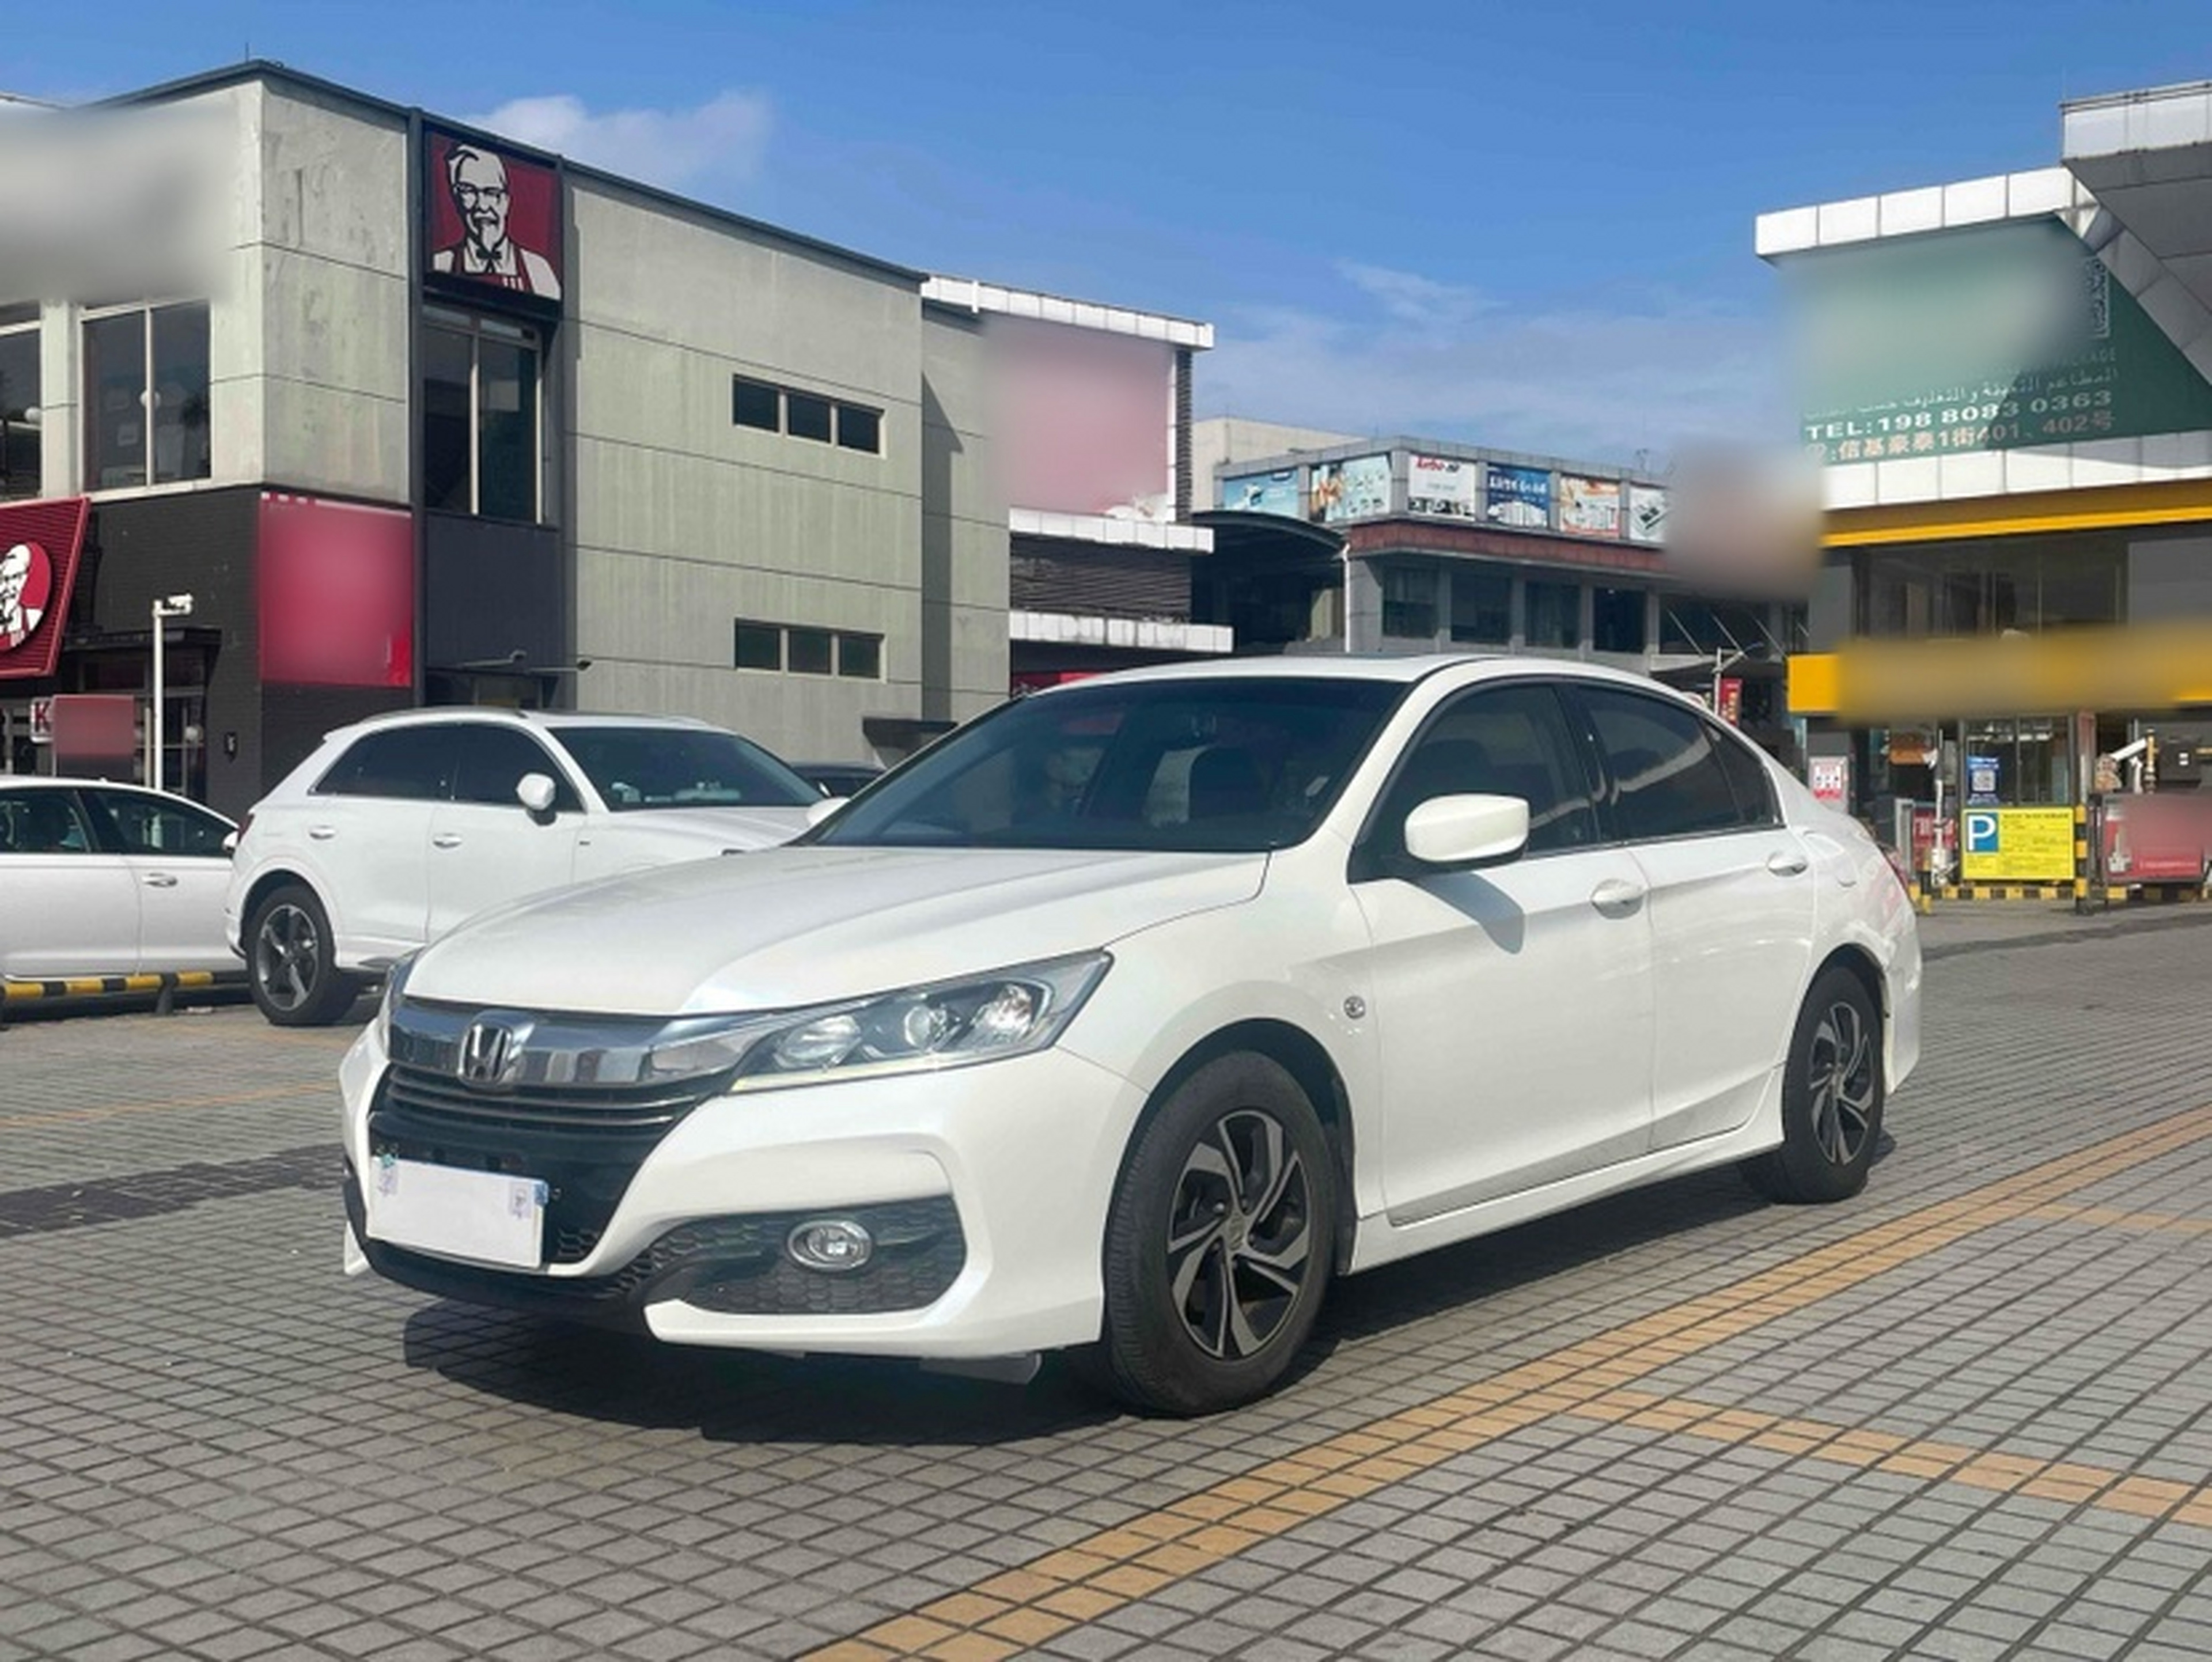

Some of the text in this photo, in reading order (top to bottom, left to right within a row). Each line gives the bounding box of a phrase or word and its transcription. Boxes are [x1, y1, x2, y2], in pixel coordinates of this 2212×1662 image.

[1805, 411, 1932, 440] TEL:198
[1941, 402, 2020, 424] 8083
[2031, 389, 2112, 414] 0363
[1968, 815, 1995, 851] P
